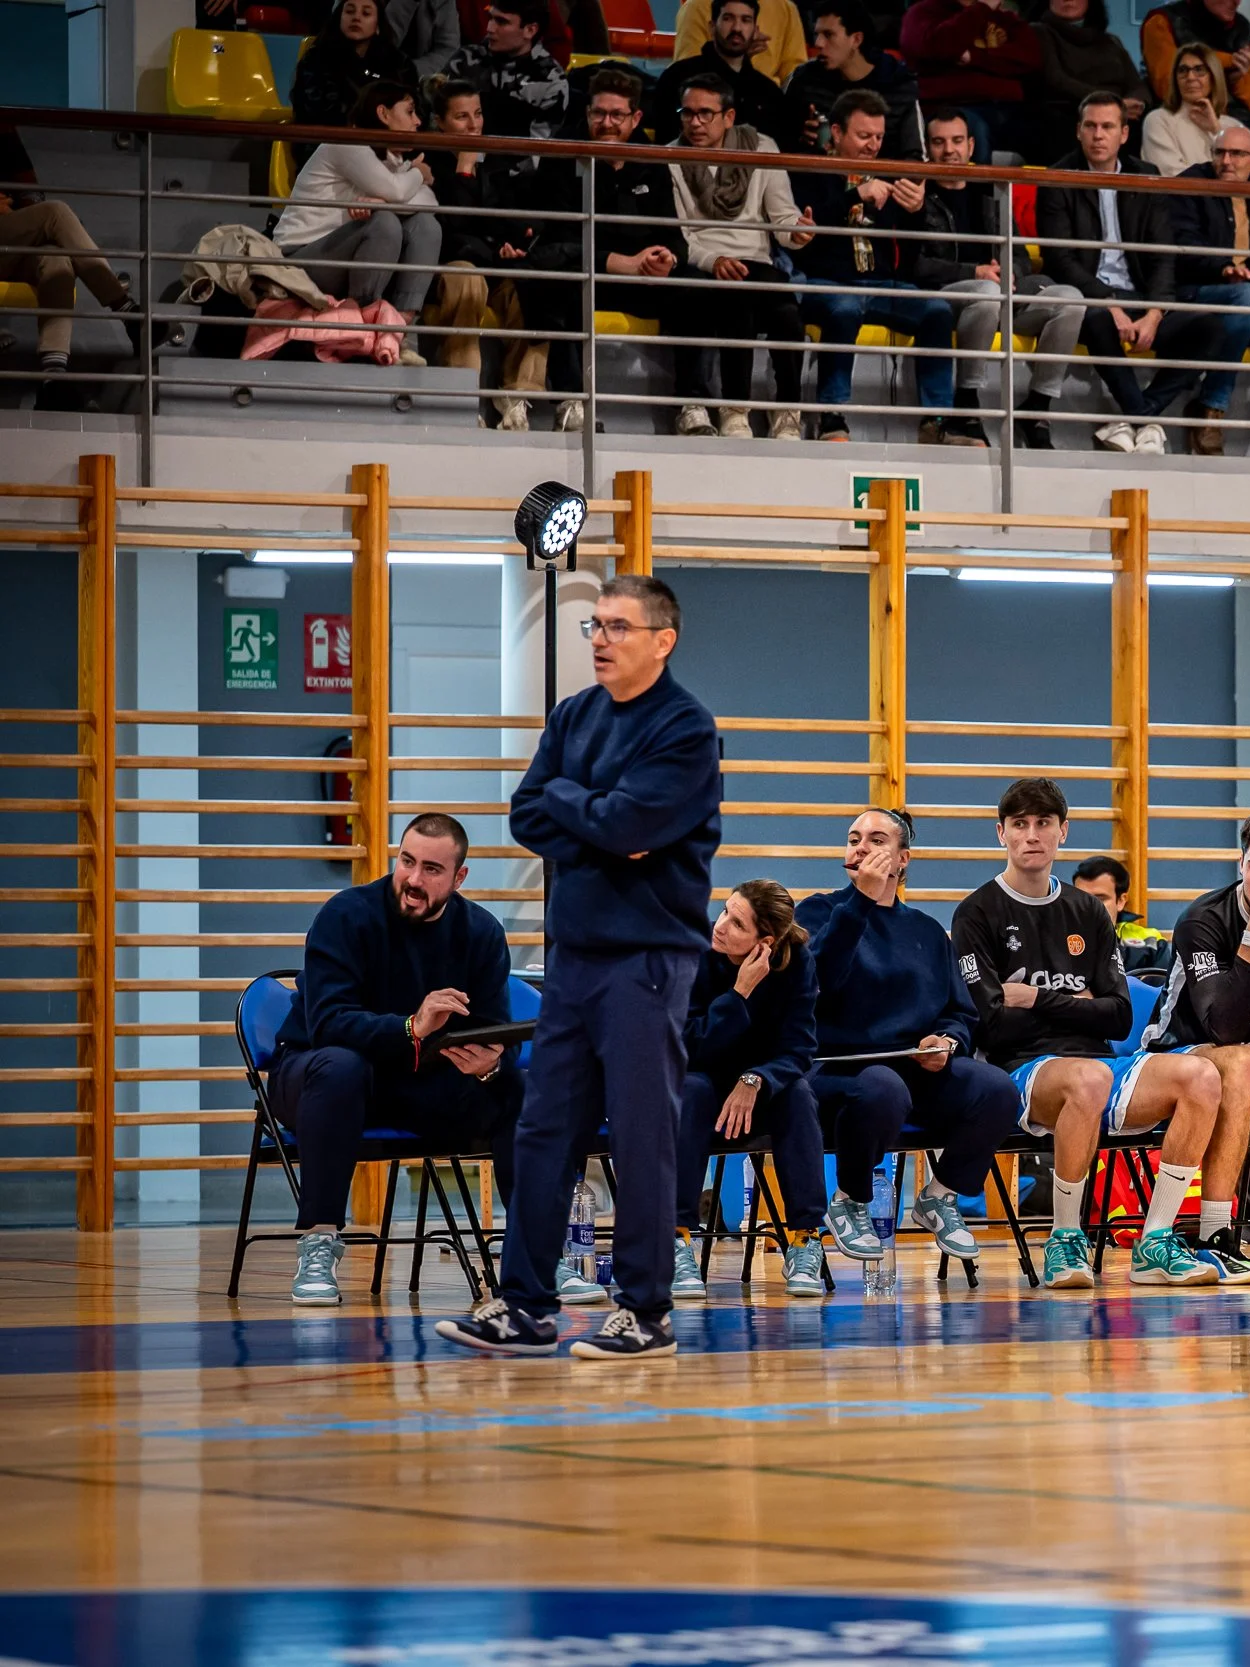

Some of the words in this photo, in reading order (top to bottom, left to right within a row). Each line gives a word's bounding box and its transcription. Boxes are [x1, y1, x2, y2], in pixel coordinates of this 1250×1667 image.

[231, 669, 259, 679] SALIDA
[261, 669, 272, 679] DE
[226, 679, 277, 689] EMERGENCIA
[1030, 970, 1087, 993] Class
